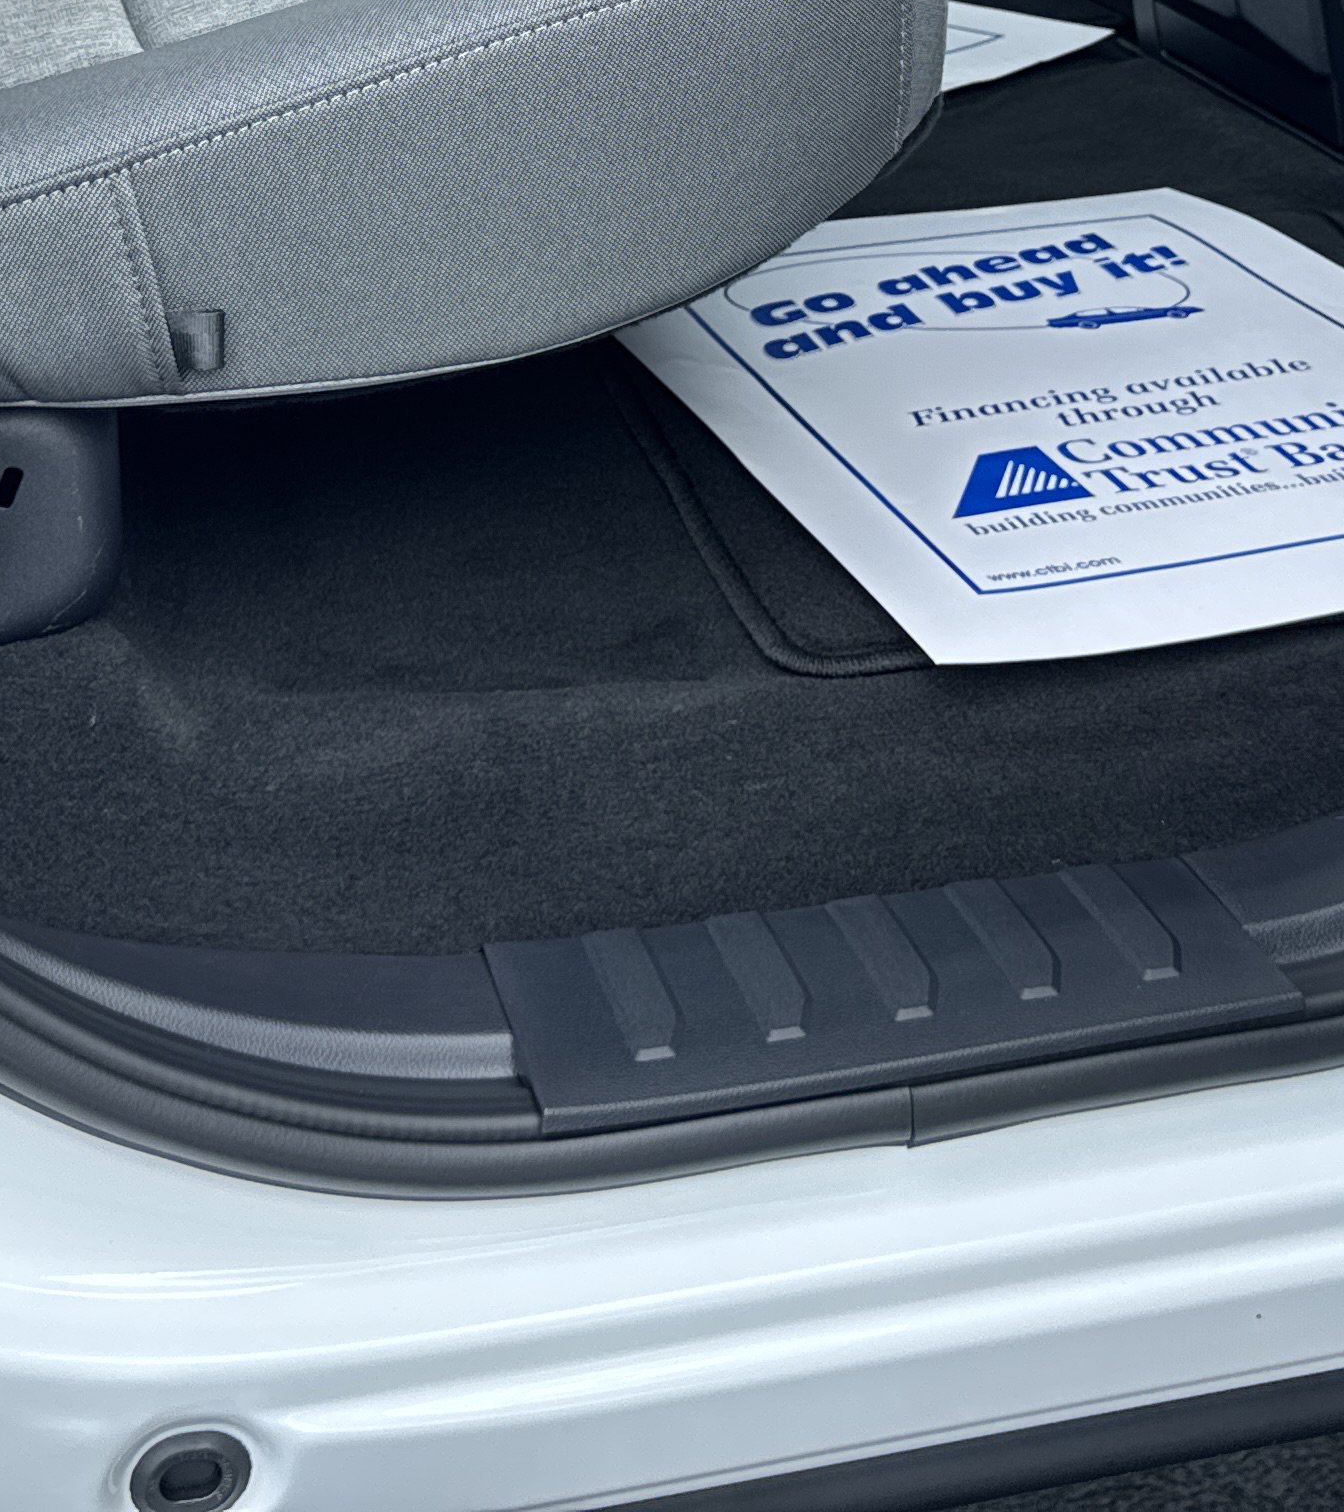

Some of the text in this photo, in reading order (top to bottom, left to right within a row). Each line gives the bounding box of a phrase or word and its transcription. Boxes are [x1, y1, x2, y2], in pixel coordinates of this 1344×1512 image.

[749, 232, 1118, 328] Go ahead
[762, 244, 1190, 360] and buy it!
[907, 357, 1314, 428] Financing available
[1055, 390, 1221, 429] through
[964, 506, 1098, 537] building
